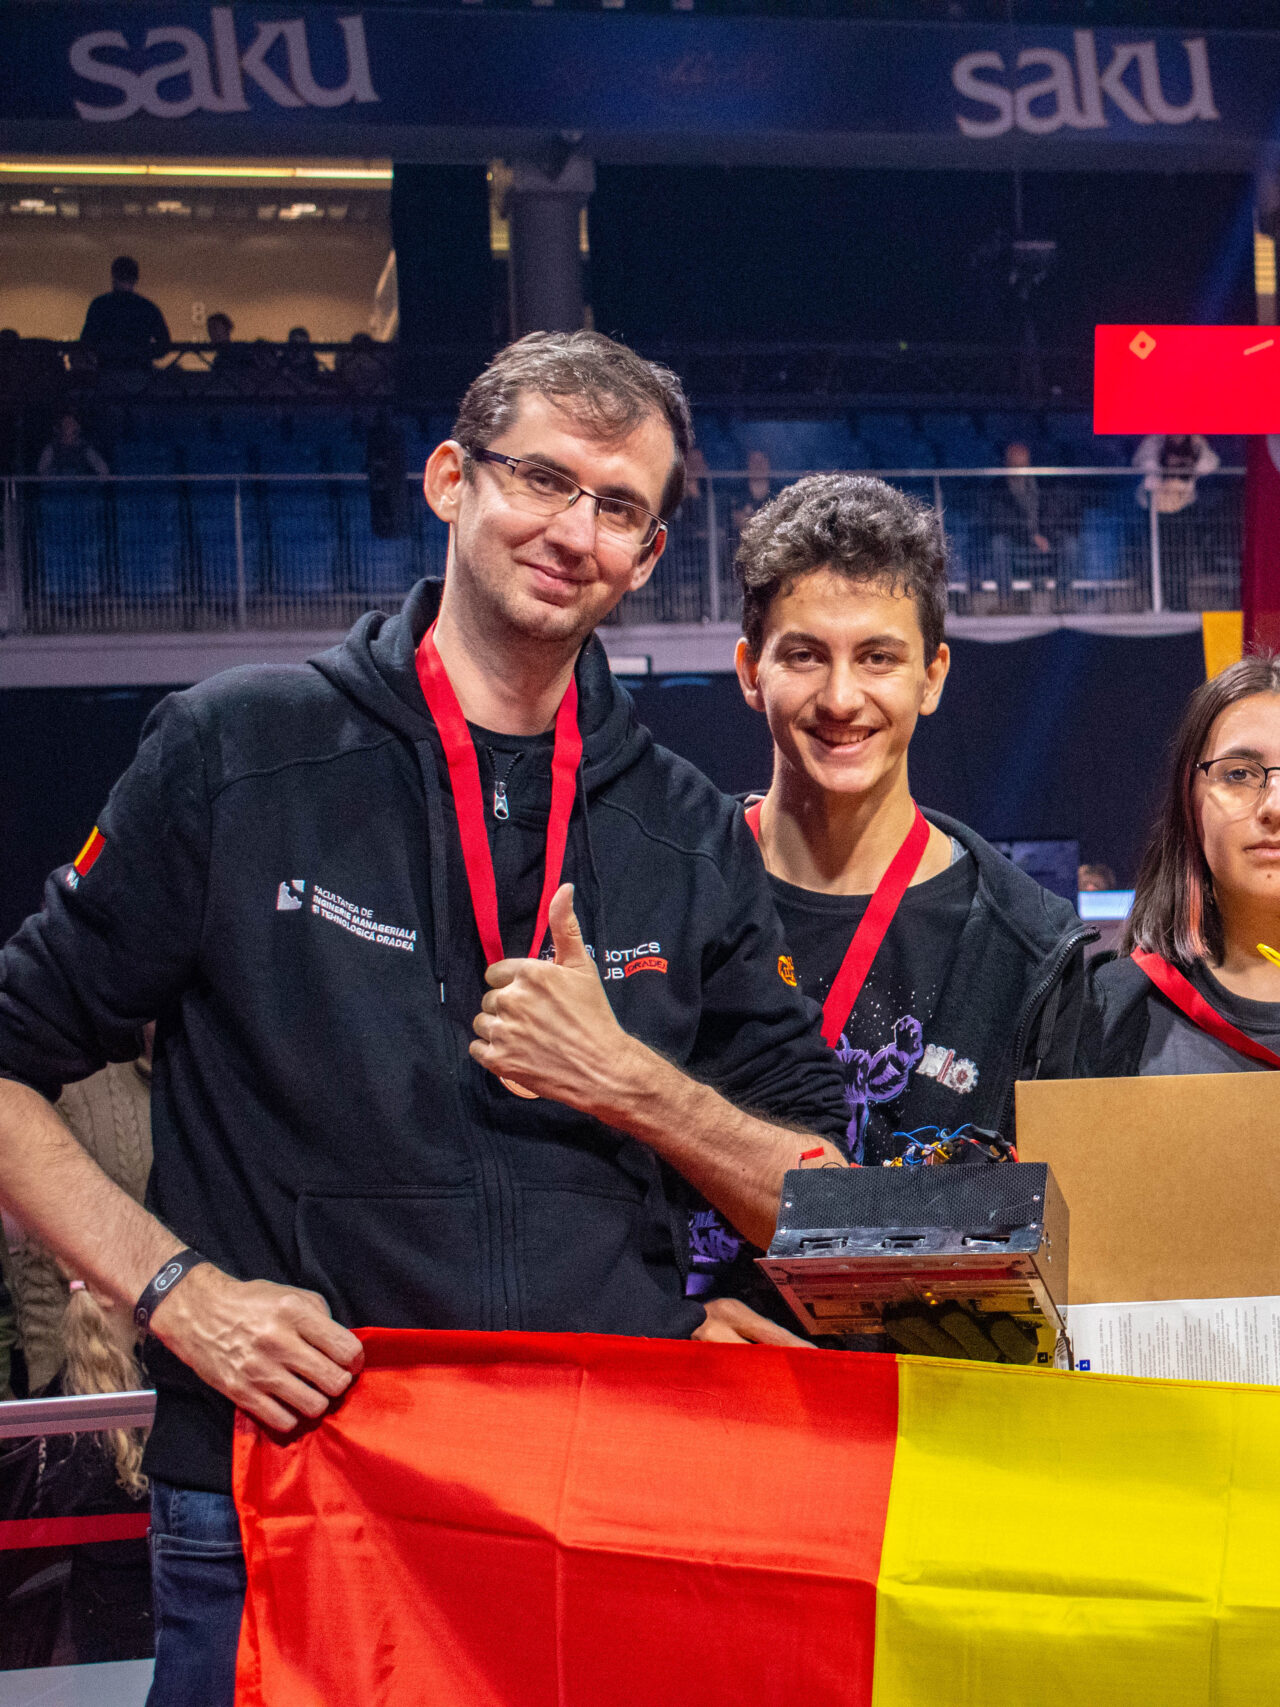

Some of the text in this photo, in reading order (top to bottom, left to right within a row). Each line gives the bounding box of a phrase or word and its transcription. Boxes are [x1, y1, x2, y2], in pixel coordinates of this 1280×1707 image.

[69, 7, 380, 123] saku
[952, 29, 1220, 139] saku
[312, 894, 351, 920] INGINERIE
[313, 885, 374, 919] FACULTATEA DE
[376, 934, 415, 952] ORADEA
